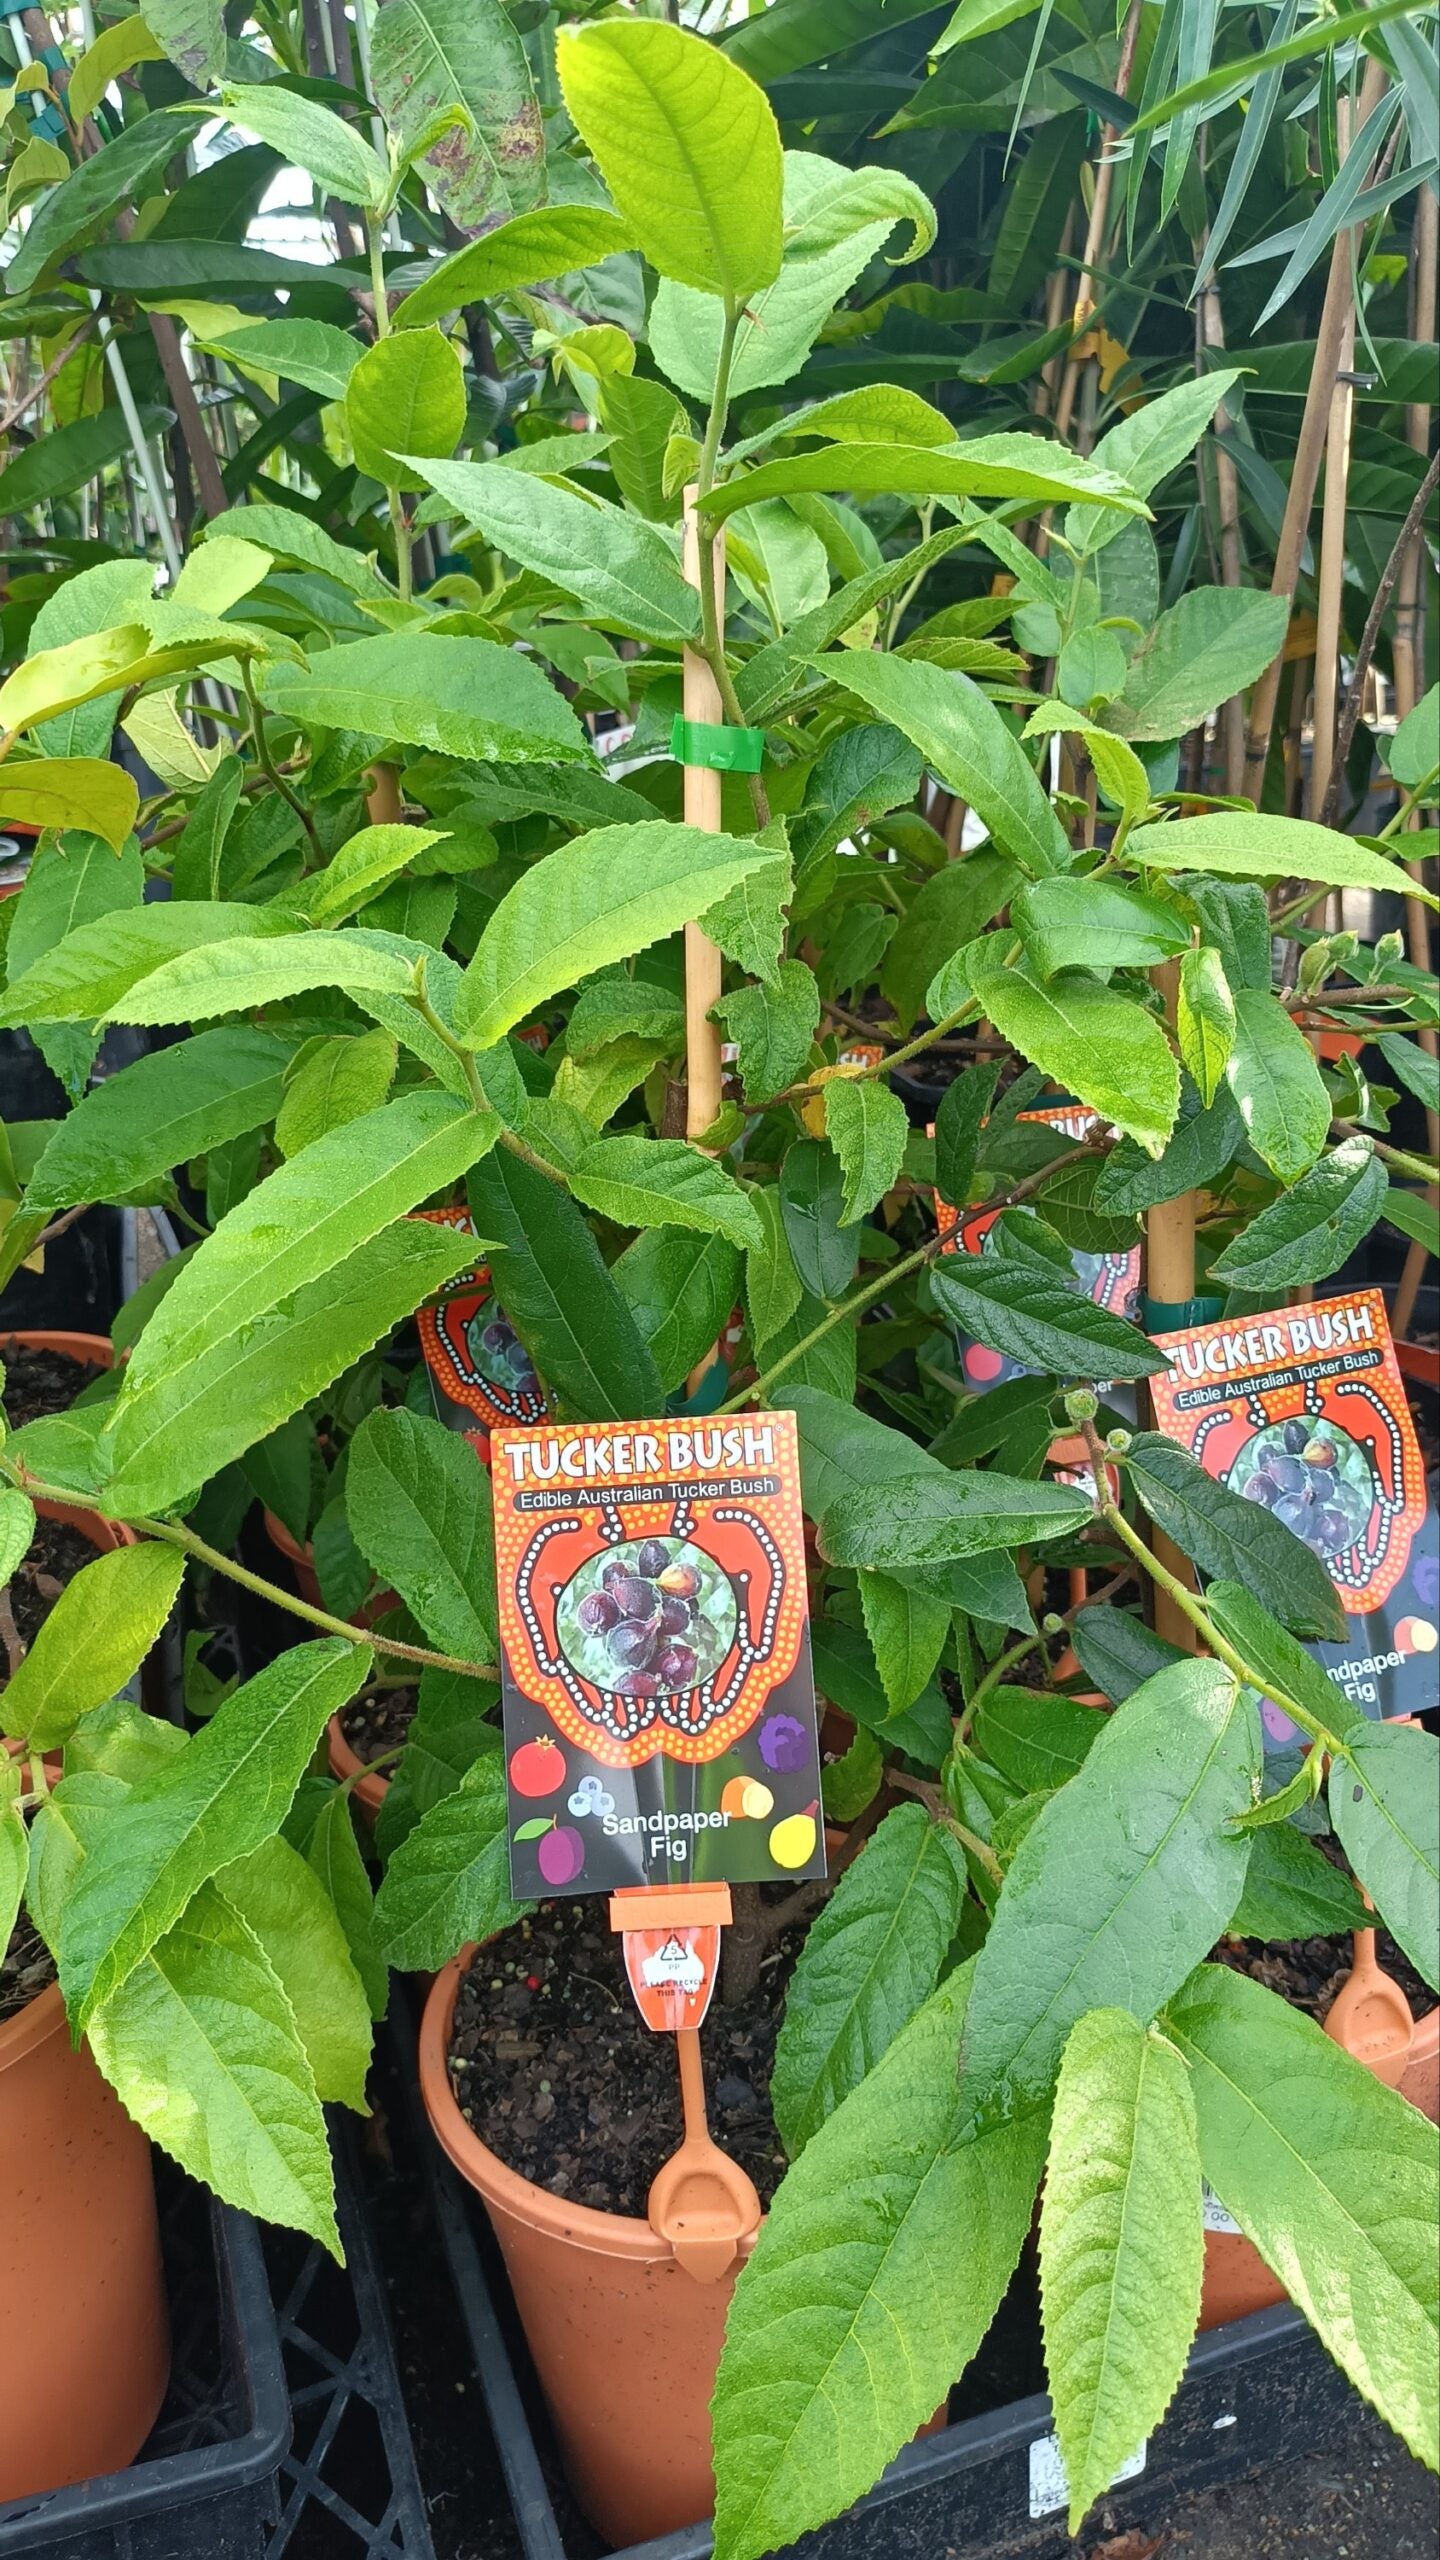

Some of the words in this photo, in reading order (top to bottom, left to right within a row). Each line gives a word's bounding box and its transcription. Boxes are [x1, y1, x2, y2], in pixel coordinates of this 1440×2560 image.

[1161, 1324, 1287, 1383] TUCKER
[1288, 1305, 1374, 1355] BUSH
[1178, 1387, 1221, 1409] Edible
[1225, 1371, 1294, 1396] Australian
[1297, 1362, 1340, 1380] Tucker
[1343, 1350, 1380, 1371] Bush
[503, 1433, 663, 1481] TUCKER
[668, 1426, 775, 1471] BUSH
[521, 1489, 572, 1509] Edible
[577, 1484, 664, 1504] Australian
[668, 1480, 725, 1499] Tucker
[731, 1478, 774, 1495] Bush
[1326, 1651, 1405, 1681] ndpaper
[1344, 1681, 1377, 1703] Fig
[602, 1810, 732, 1836] Sandpaper
[650, 1836, 688, 1861] Fig
[673, 1978, 708, 1987] RECYCLE
